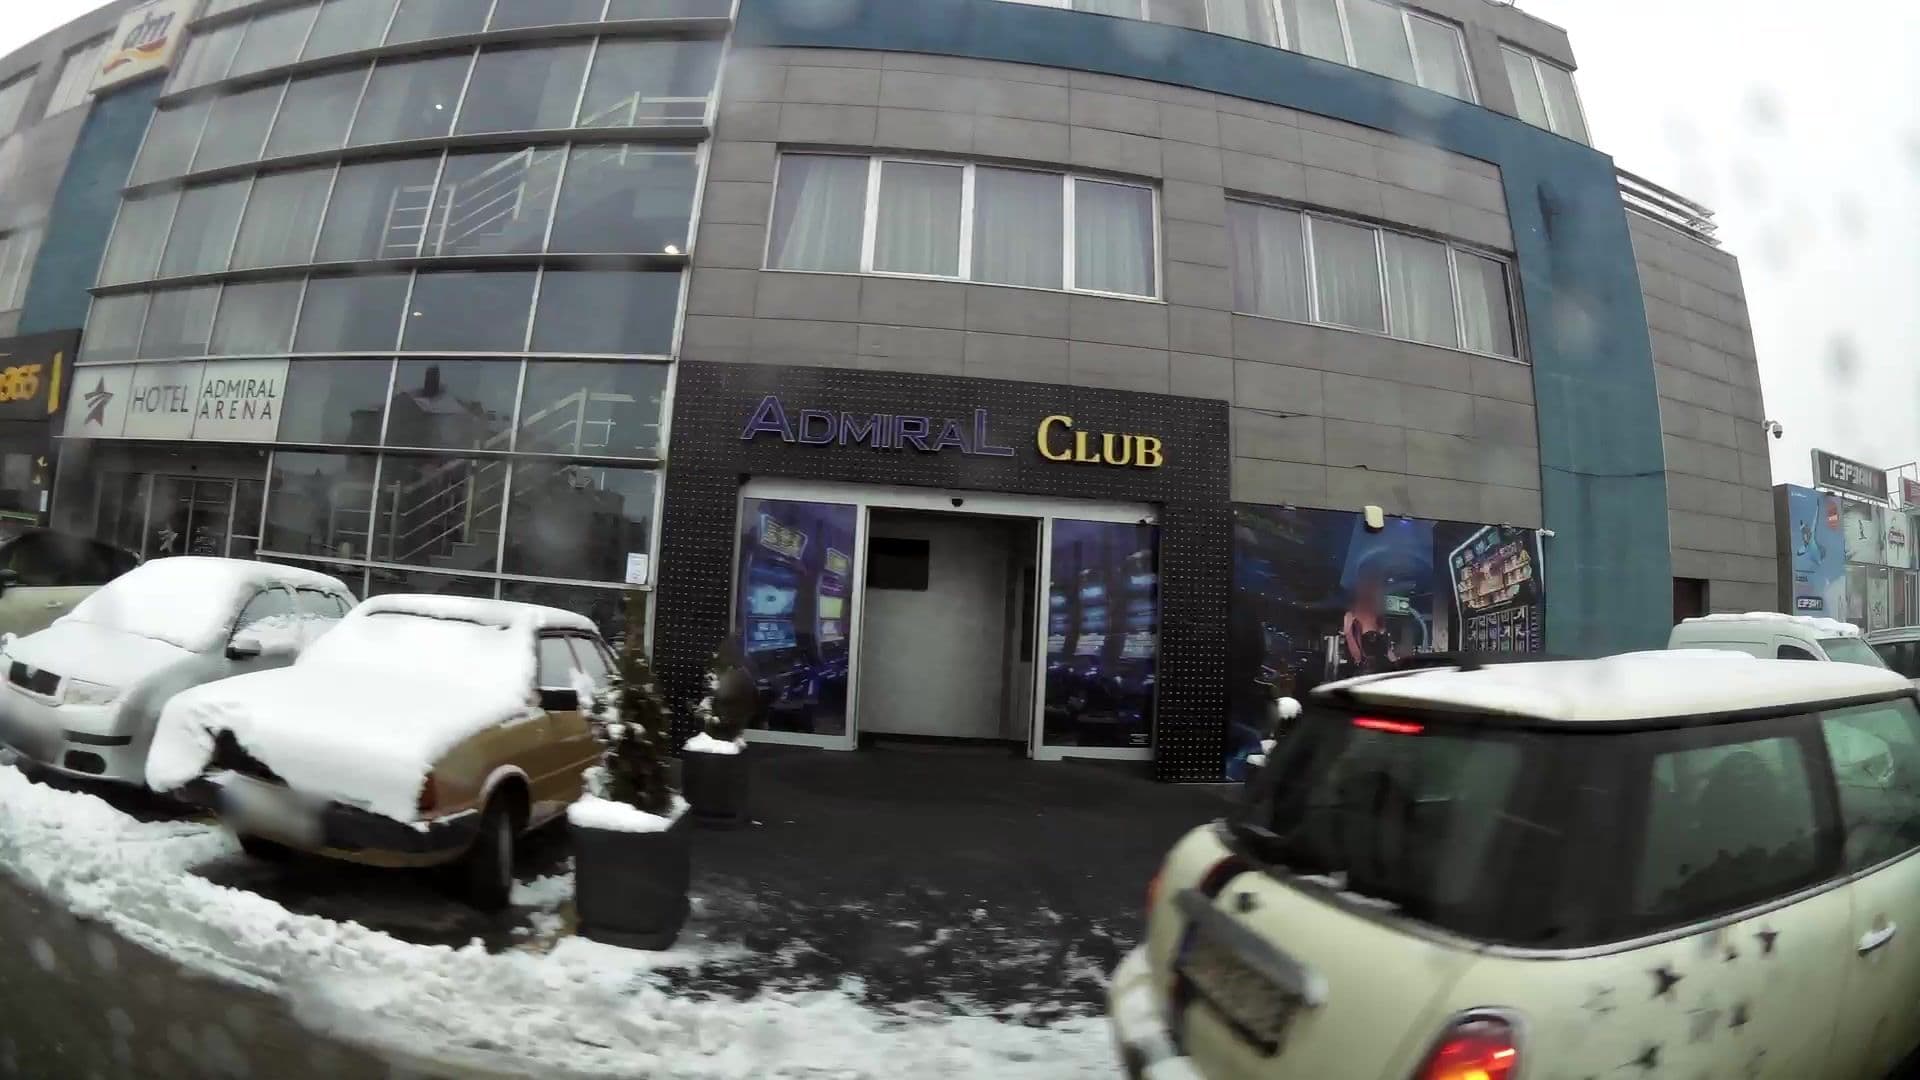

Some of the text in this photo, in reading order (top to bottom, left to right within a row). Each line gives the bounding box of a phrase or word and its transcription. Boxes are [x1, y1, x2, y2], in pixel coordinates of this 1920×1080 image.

[132, 384, 189, 413] HOTEL
[202, 378, 276, 399] ADMIRAL
[199, 400, 273, 420] ARENA
[740, 395, 1164, 468] ADMIRAL CLUB
